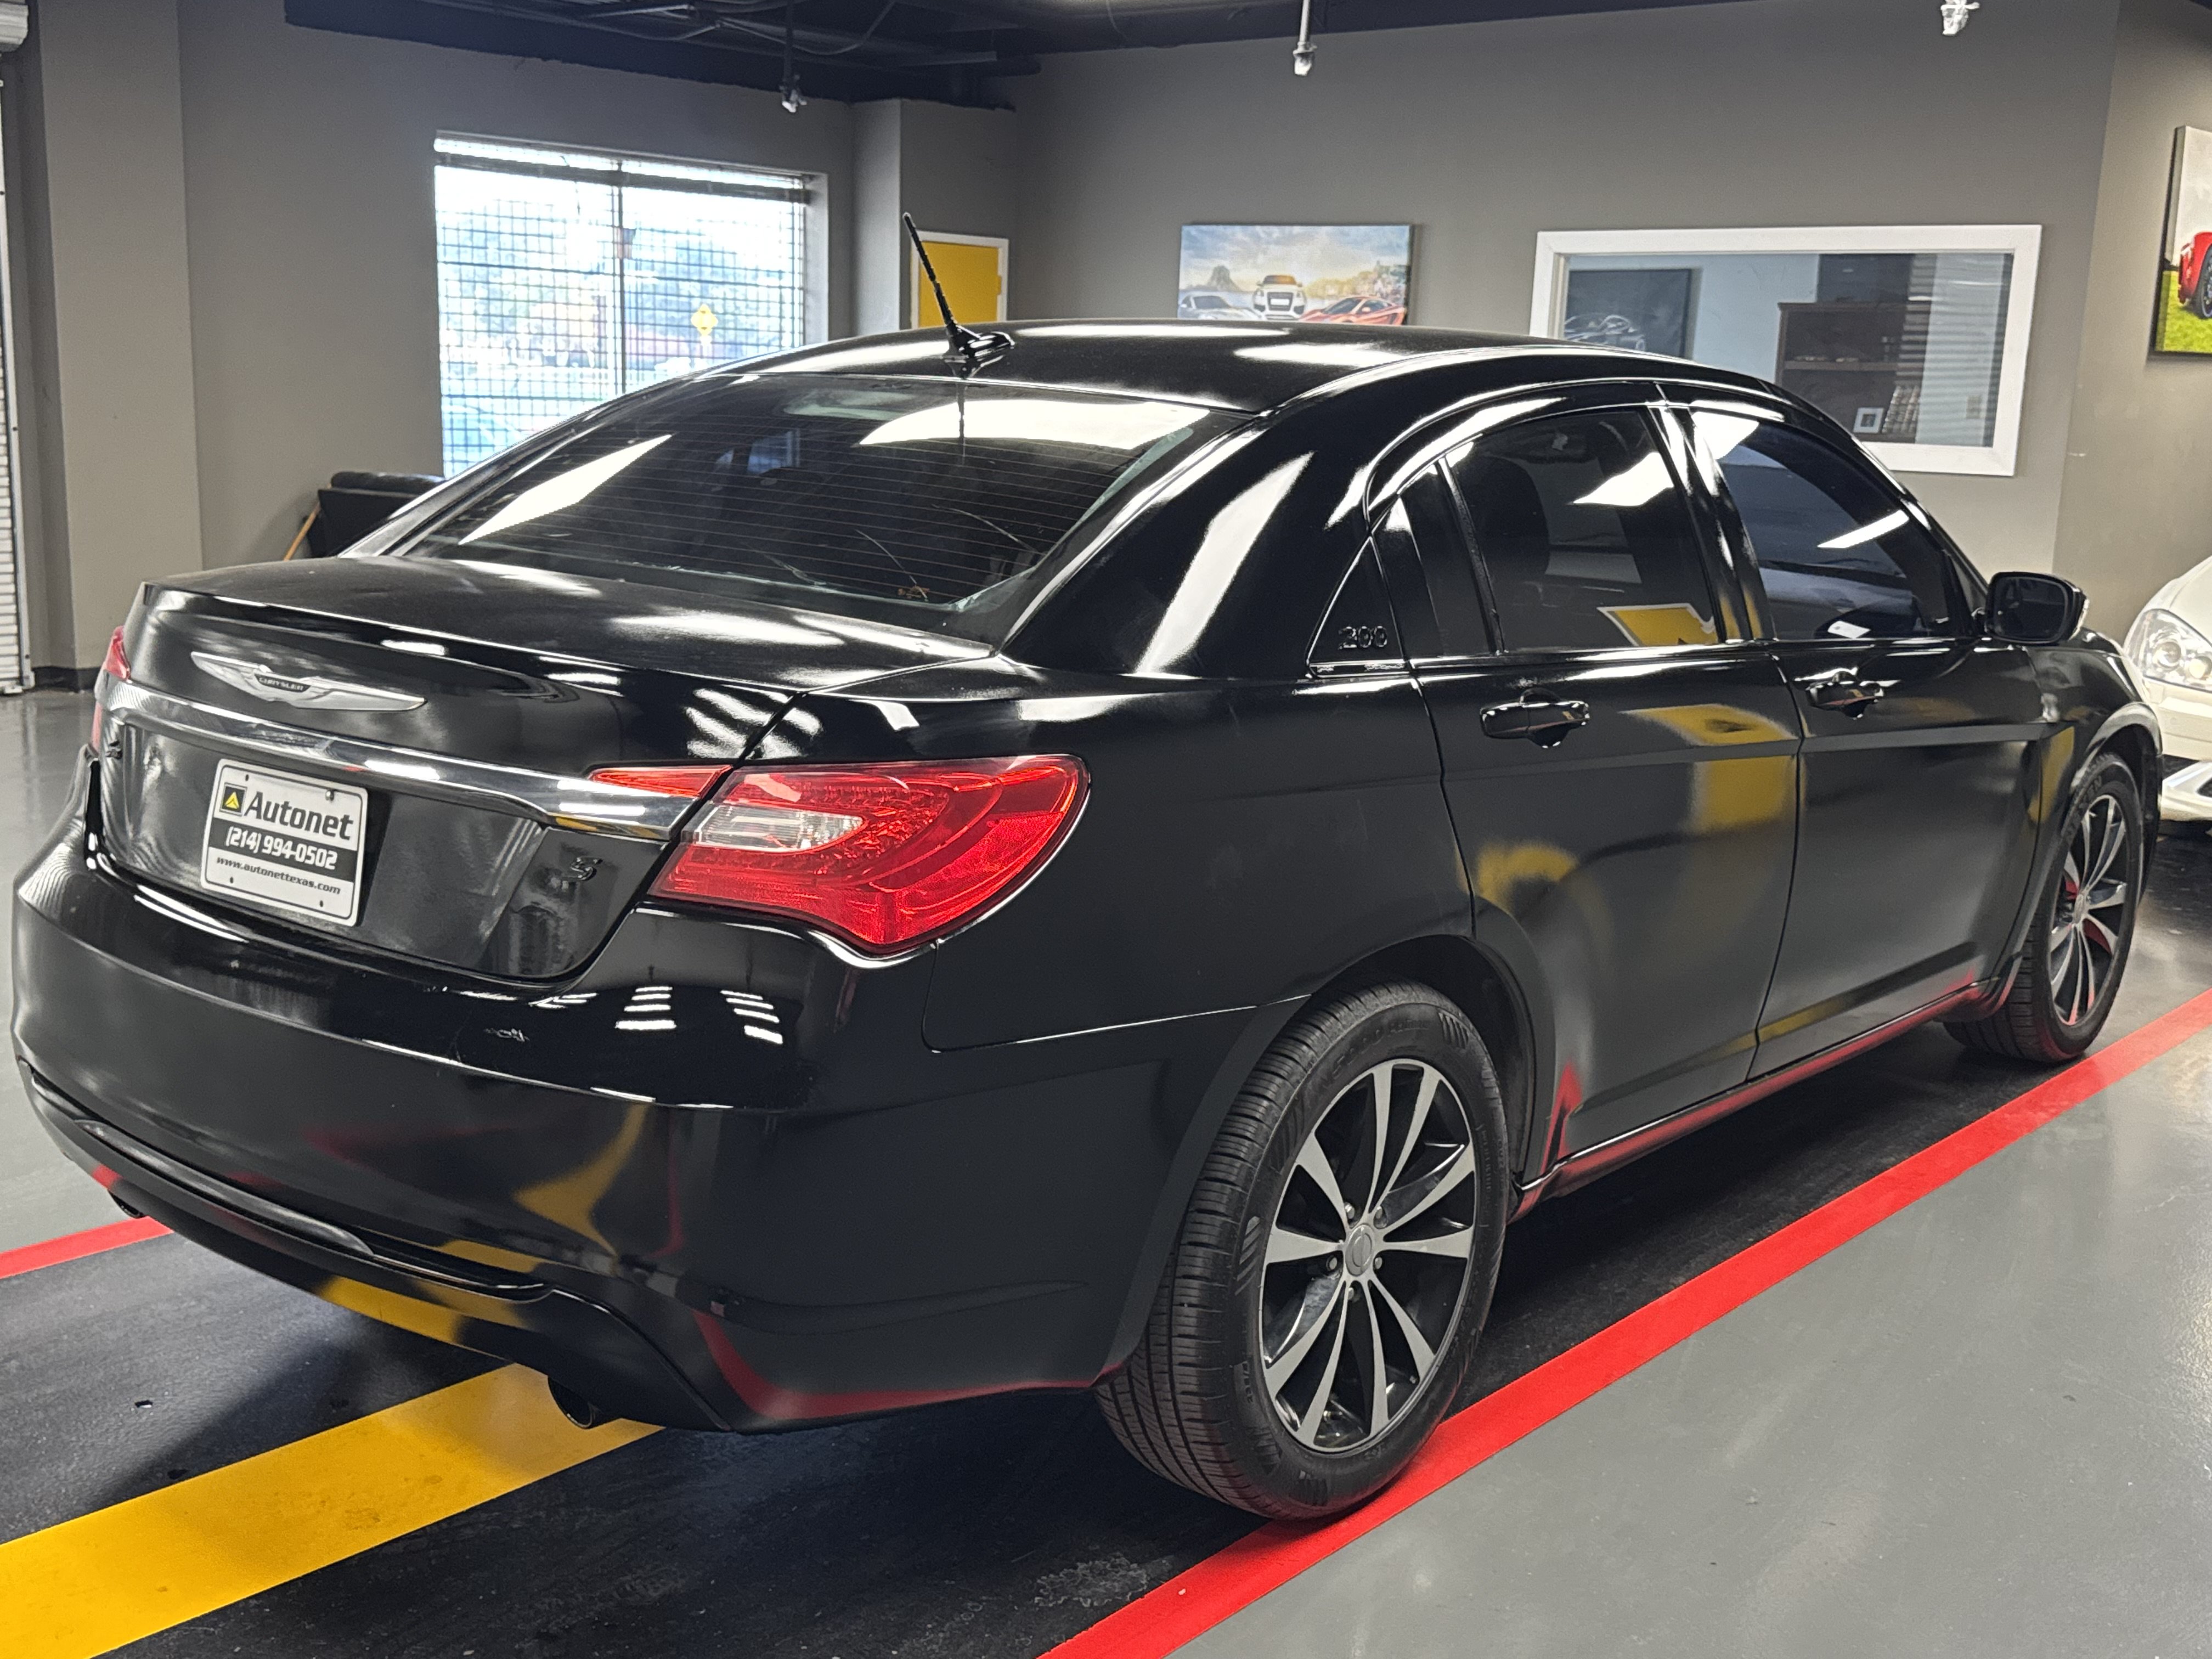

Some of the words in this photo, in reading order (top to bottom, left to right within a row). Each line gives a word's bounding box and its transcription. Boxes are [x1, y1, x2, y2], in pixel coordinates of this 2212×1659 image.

[1338, 626, 1388, 650] 200
[244, 791, 354, 840] Autonet
[225, 826, 261, 853] (214)
[262, 835, 338, 870] 994-0502
[217, 857, 341, 895] www.autonettexas.com
